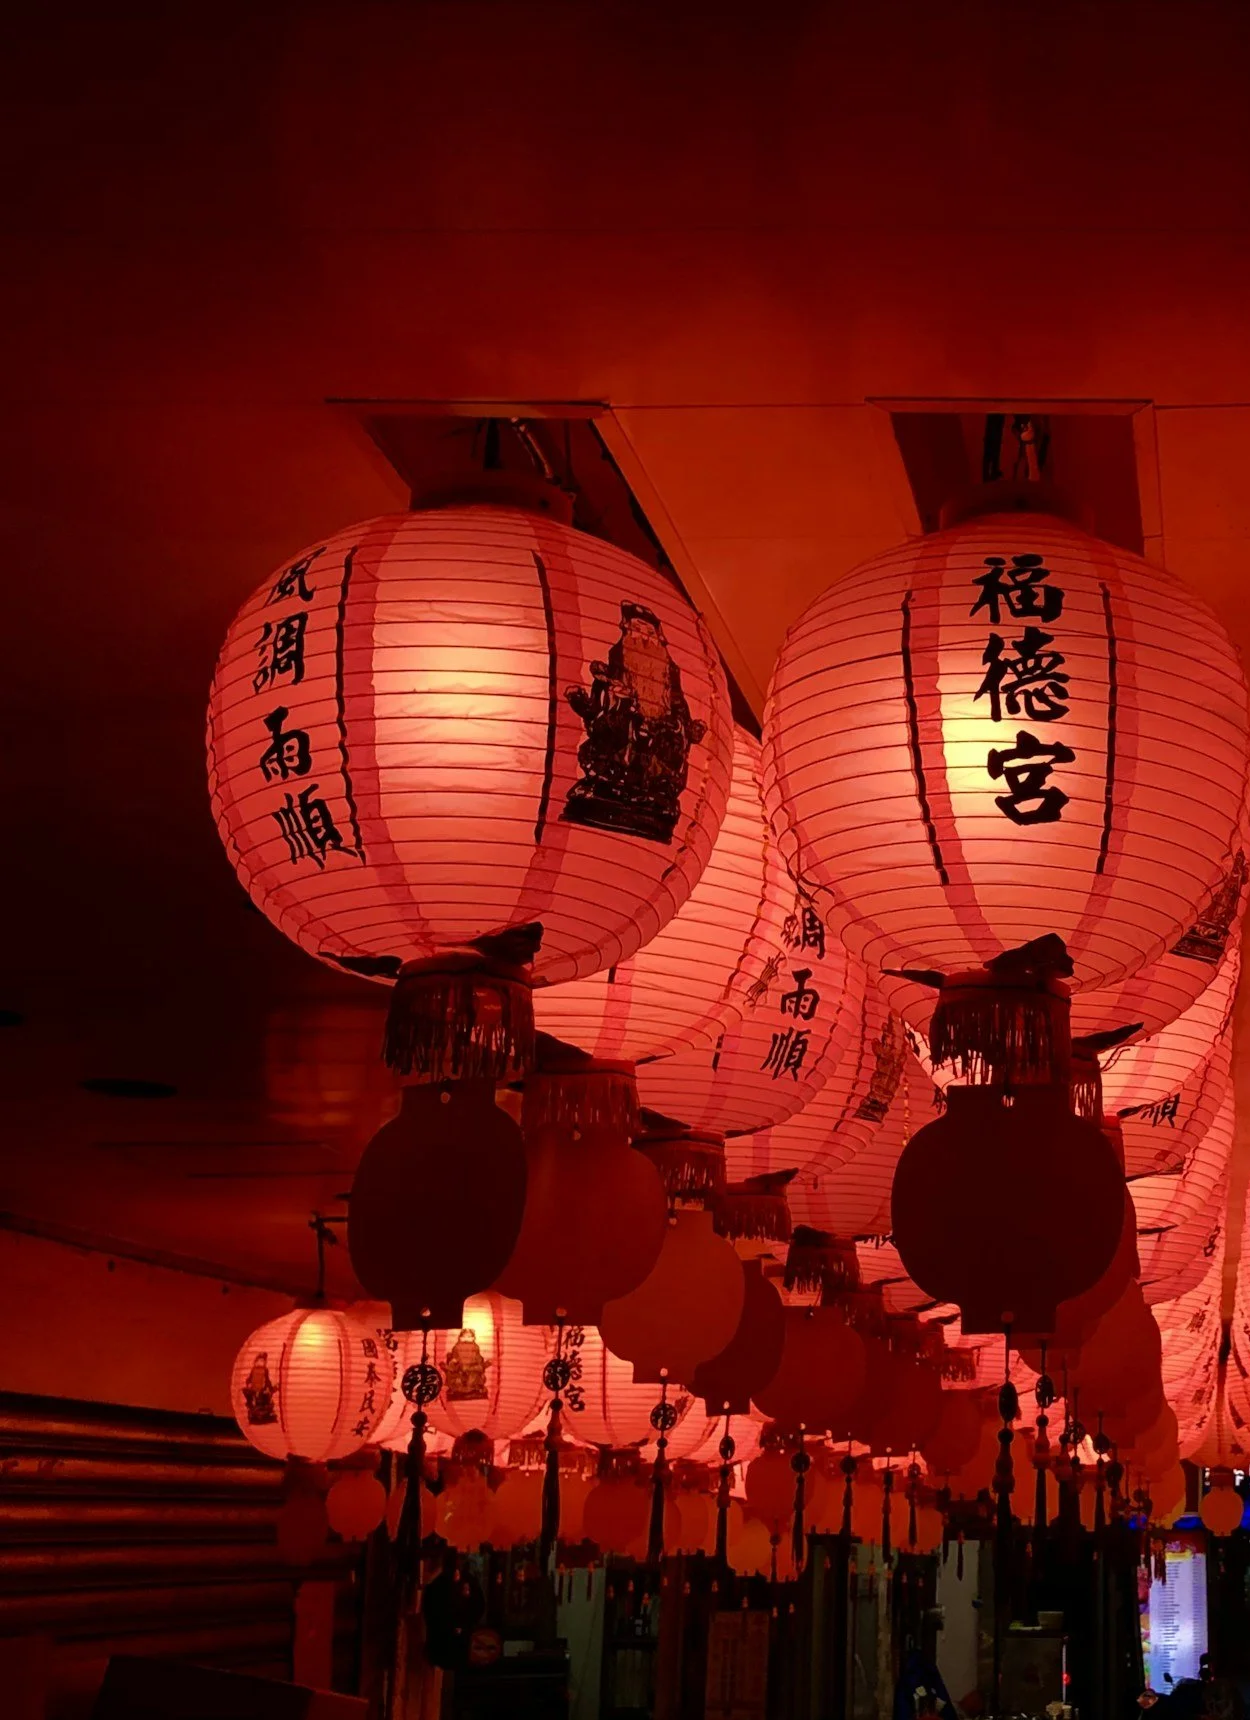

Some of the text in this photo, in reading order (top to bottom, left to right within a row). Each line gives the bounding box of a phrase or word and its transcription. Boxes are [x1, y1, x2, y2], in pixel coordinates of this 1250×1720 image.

[252, 546, 358, 870] 風調雨順
[969, 553, 1076, 826] 福德宮
